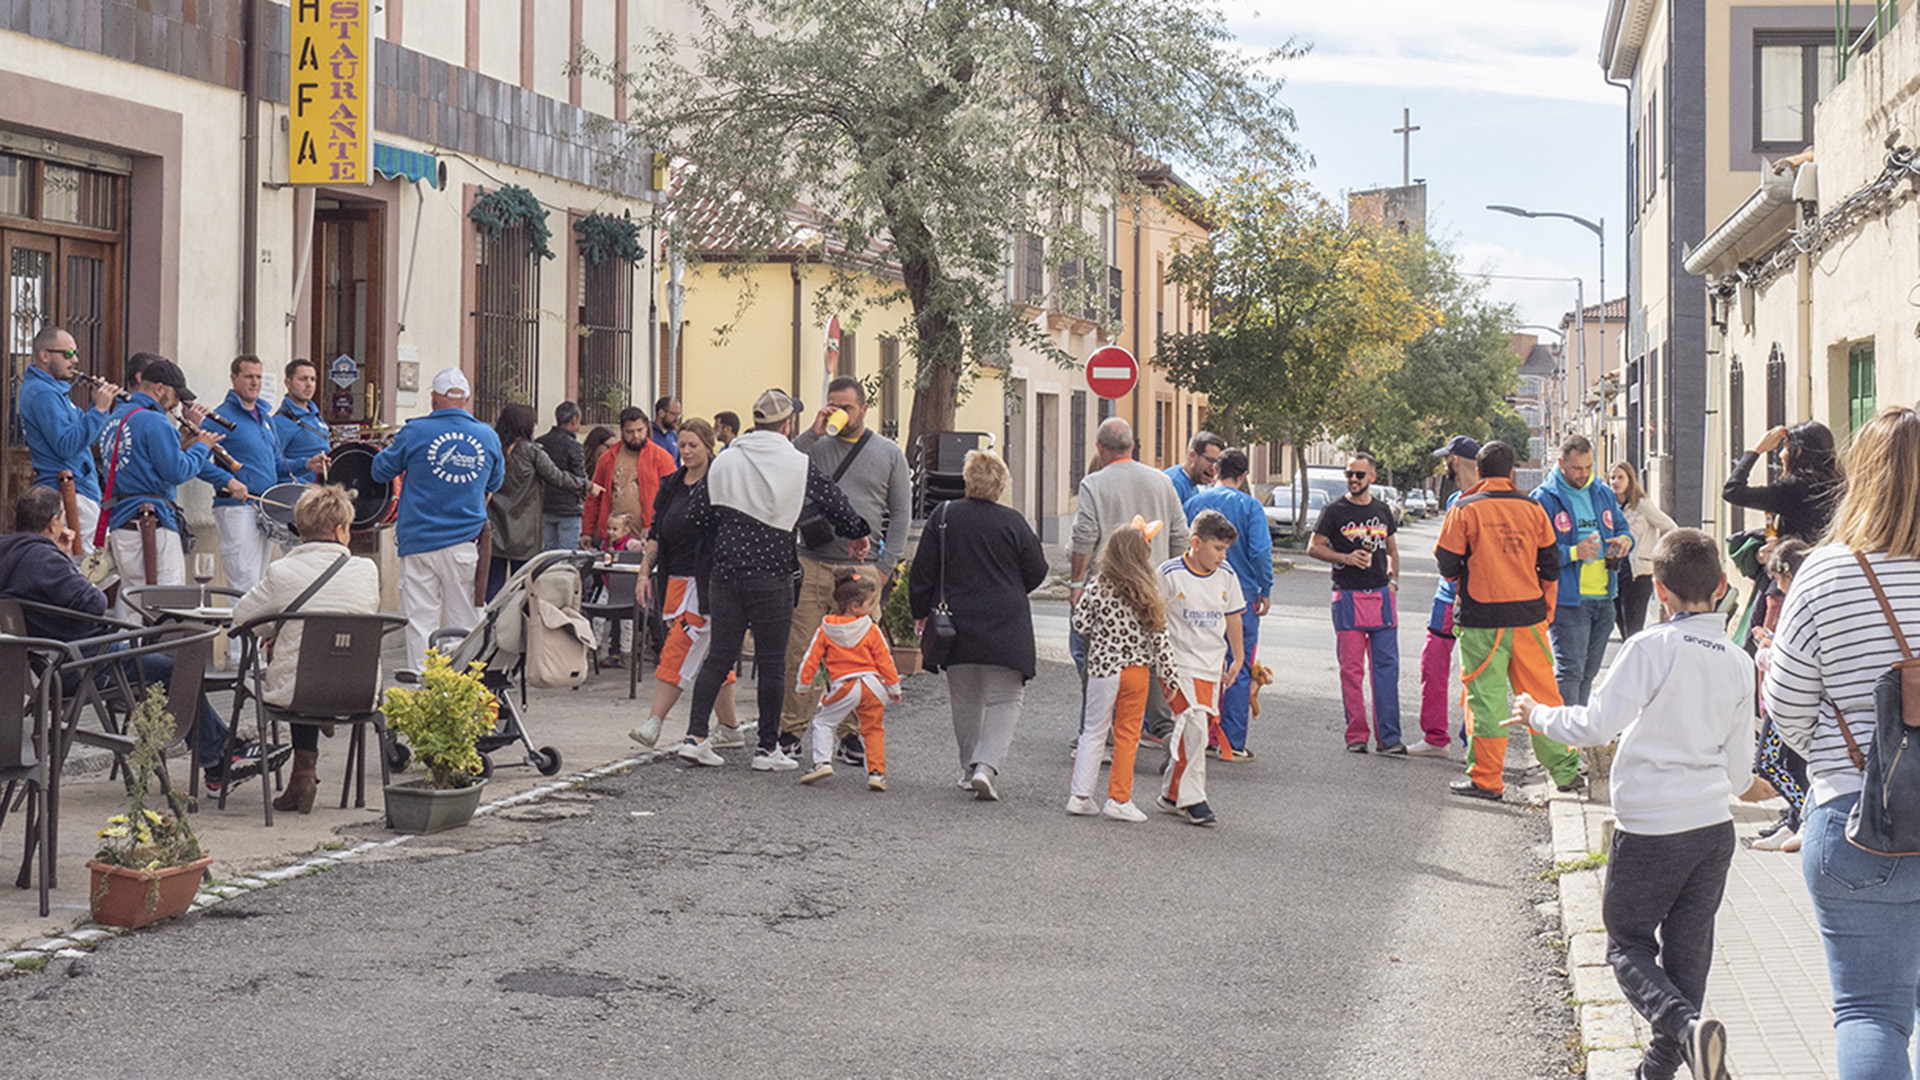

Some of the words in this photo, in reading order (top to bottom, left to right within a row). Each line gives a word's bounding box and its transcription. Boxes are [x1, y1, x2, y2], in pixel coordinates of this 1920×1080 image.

[297, 0, 319, 164] HAFA
[328, 1, 359, 180] STAURANTE
[432, 467, 479, 483] SEGOVIA
